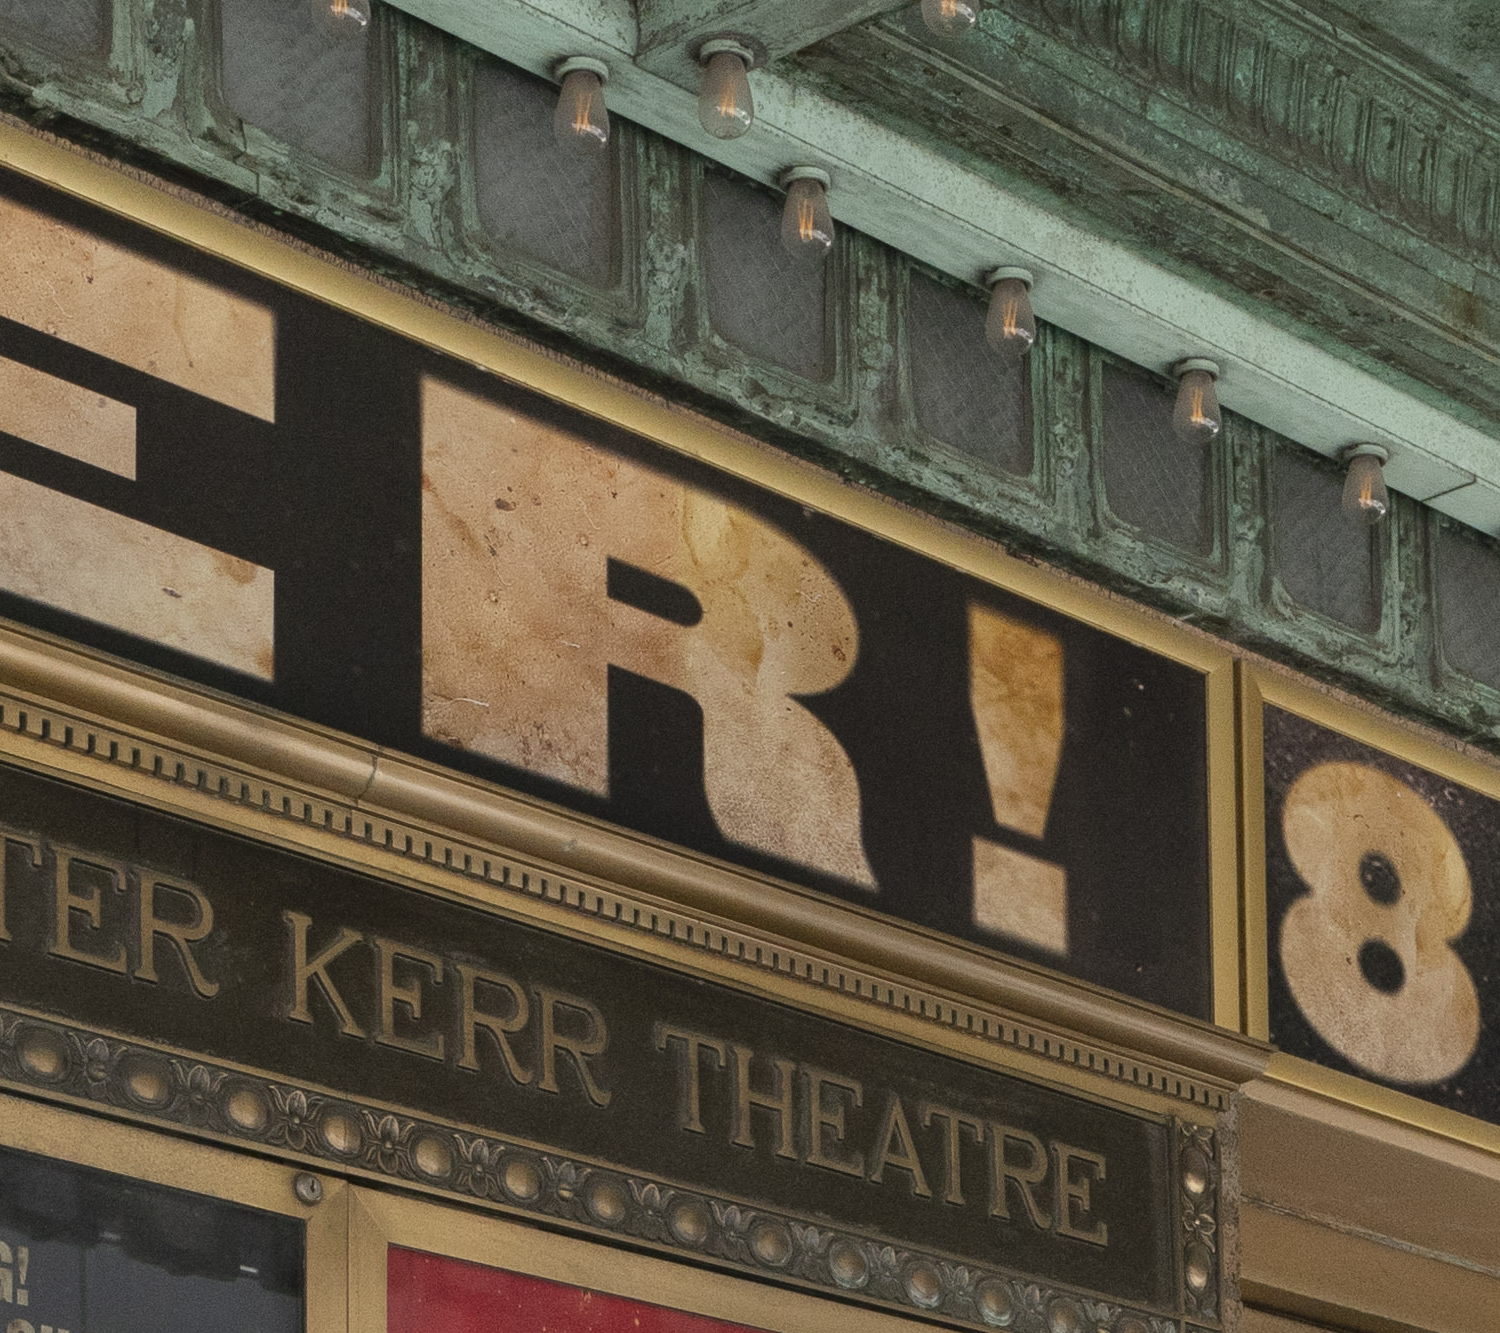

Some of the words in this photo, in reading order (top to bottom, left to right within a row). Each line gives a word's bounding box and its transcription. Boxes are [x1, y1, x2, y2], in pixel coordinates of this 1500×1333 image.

[282, 908, 613, 1108] KERR
[655, 1021, 1110, 1247] THEATRE
[1280, 759, 1482, 1088] 8
